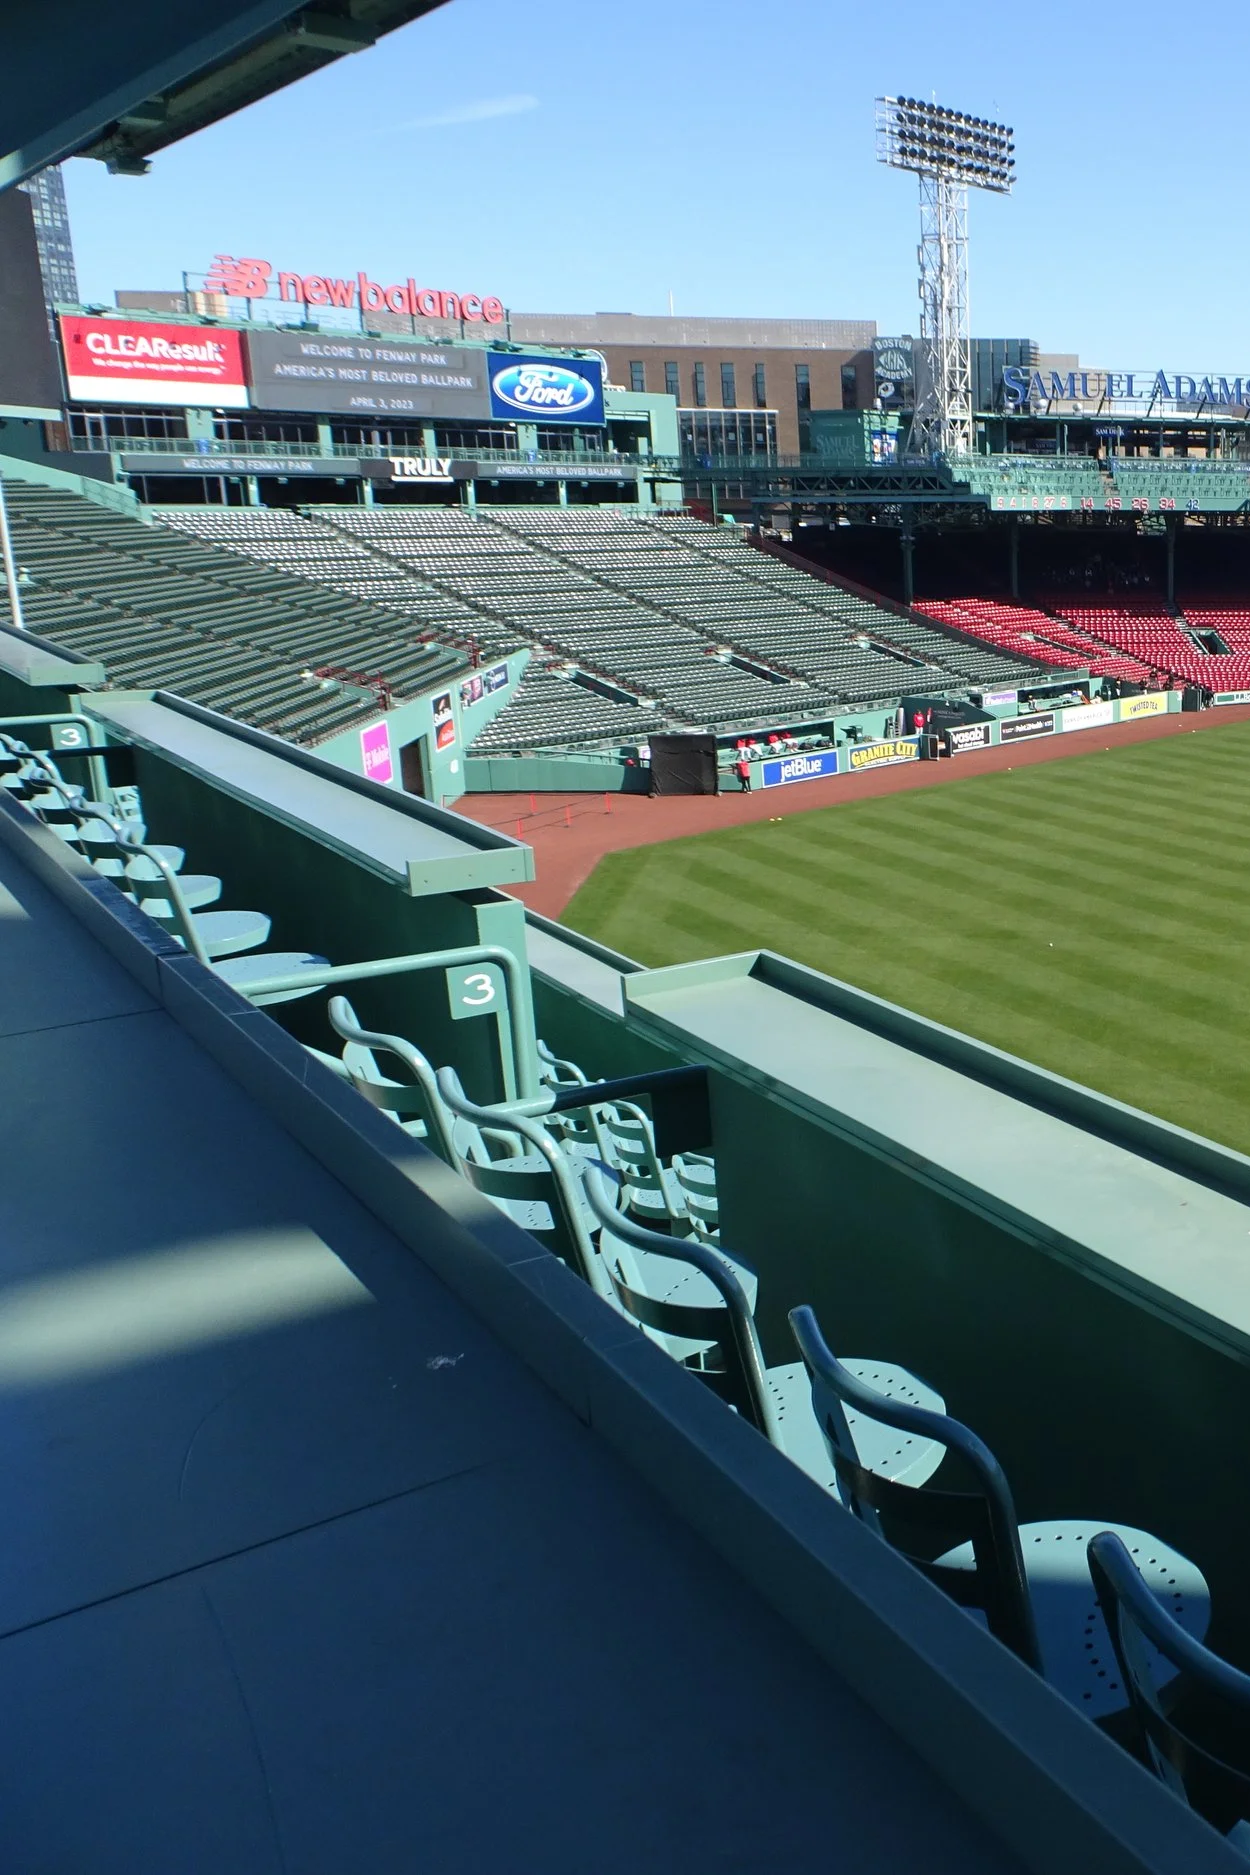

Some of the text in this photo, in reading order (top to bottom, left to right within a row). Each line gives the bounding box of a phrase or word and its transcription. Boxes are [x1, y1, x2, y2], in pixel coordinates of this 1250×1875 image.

[300, 343, 447, 365] WELCOME TO FENWAY PARK
[875, 338, 912, 351] BOSTON
[274, 363, 473, 388] AMERICA'S MOST BELOVED BALLPARK
[1003, 365, 1143, 405] SAMUEL
[514, 370, 574, 406] Ford
[350, 397, 414, 411] APRIL 3, 2023
[1096, 428, 1107, 436] SAM
[183, 458, 313, 472] WELCOME TO FENWAY PARK
[389, 456, 451, 477] TRULY
[496, 466, 622, 477] AMERICA'S MOST BELOVED BALLPARK
[1010, 497, 1016, 508] 4
[1044, 497, 1056, 509] 27
[1080, 497, 1094, 508] 14
[1104, 497, 1121, 509] 45
[1132, 497, 1149, 509] 26
[1159, 497, 1175, 509] 34
[1186, 498, 1200, 510] 42
[1130, 701, 1158, 714] TWISTED TEA
[60, 729, 82, 746] 3
[851, 741, 919, 766] GRANITE CITY
[780, 757, 822, 782] jetBlue
[463, 974, 495, 1005] 3
